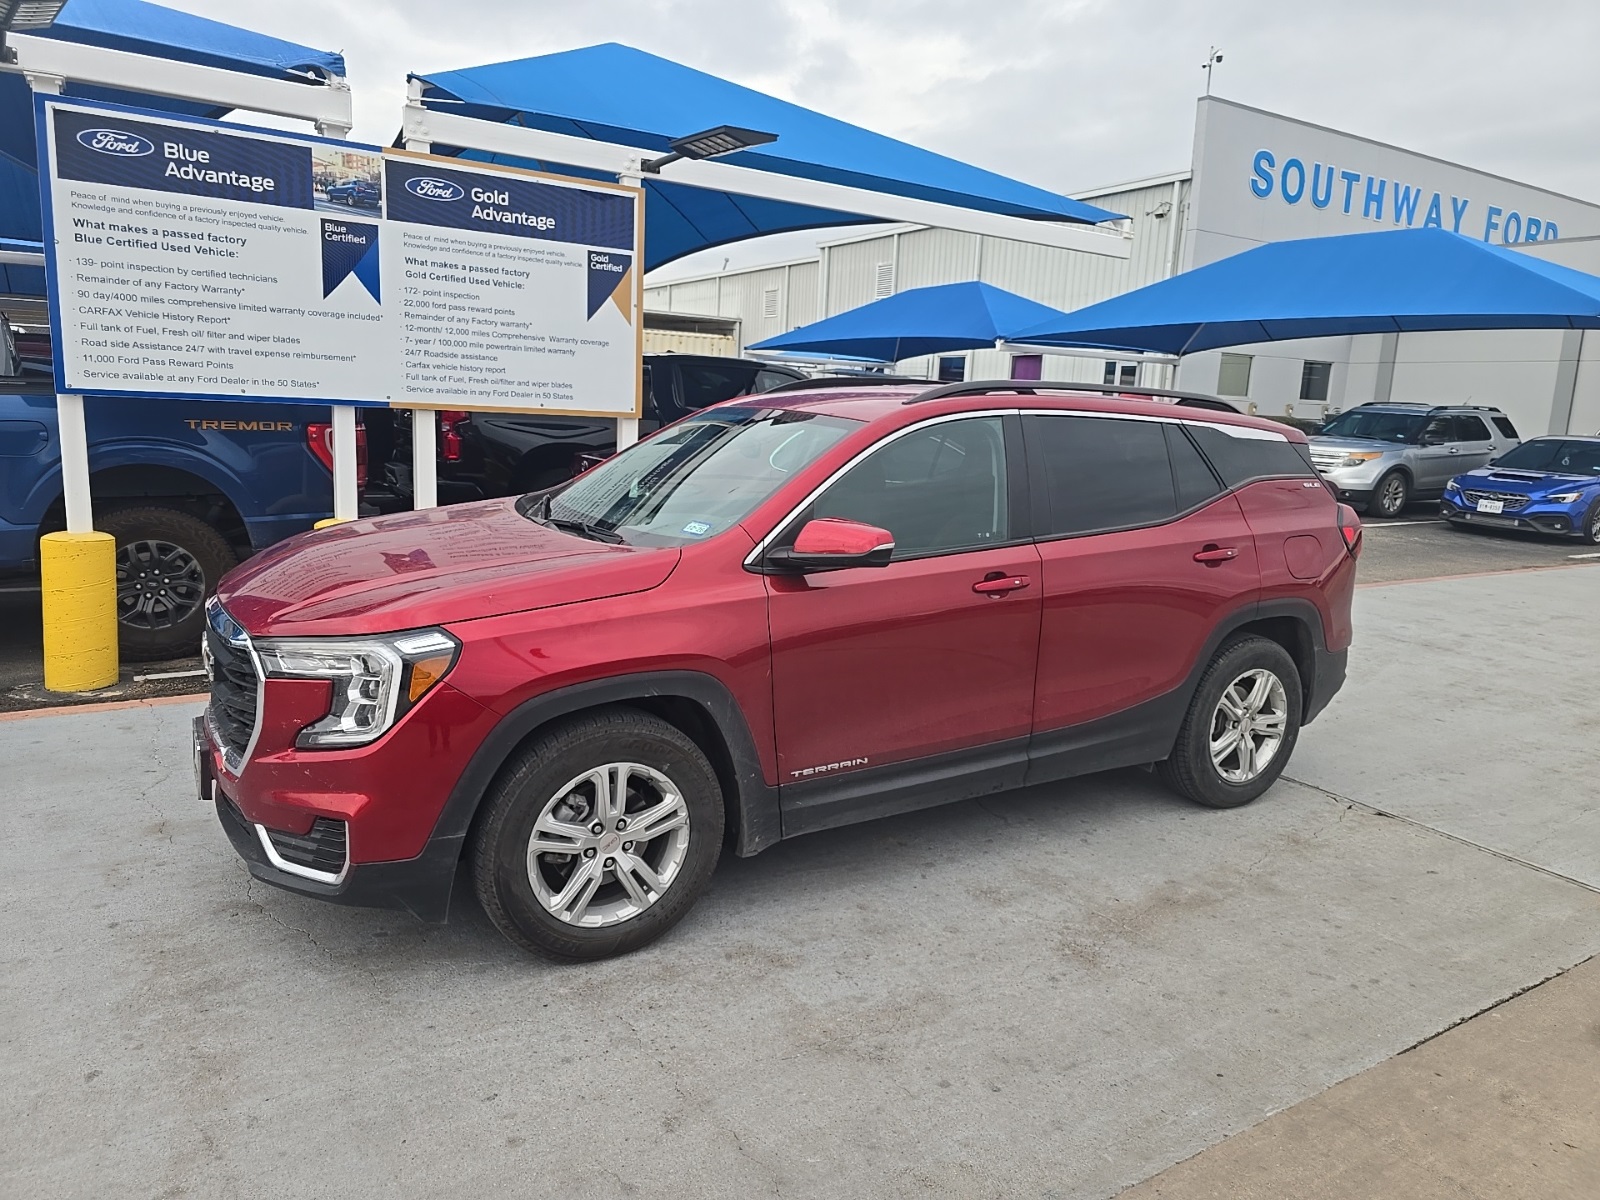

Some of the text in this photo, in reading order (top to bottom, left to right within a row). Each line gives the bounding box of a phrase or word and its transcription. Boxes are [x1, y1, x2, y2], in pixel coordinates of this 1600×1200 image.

[92, 131, 140, 153] Ford
[163, 141, 209, 163] Blue
[164, 161, 274, 192] Advantage
[416, 179, 454, 198] Ford
[470, 187, 508, 205] Gold
[1250, 149, 1470, 233] SOUTHWAY
[471, 204, 555, 230] Advantage
[72, 217, 105, 230] What
[108, 223, 148, 234] makes
[161, 229, 204, 240] passed
[206, 232, 246, 247] factory
[324, 222, 346, 232] Blue
[74, 232, 238, 258] Blue Certified Used Vehicle:
[324, 231, 366, 244] Certified
[590, 253, 608, 262] Gold
[590, 261, 622, 272] Certified
[75, 257, 278, 283] 139- point inspection by certified technicians
[404, 256, 427, 266] What
[430, 260, 458, 269] makes
[468, 265, 498, 274] passed
[501, 267, 530, 279] factory
[76, 273, 130, 285] Remainder
[132, 278, 142, 286] of
[144, 281, 161, 289] any
[164, 281, 198, 292] Factory
[405, 269, 524, 289] Gold Certified Used Vehicle:
[403, 298, 430, 307] 22,000
[431, 301, 446, 309] ford
[422, 289, 441, 297] point
[442, 291, 479, 300] inspection
[76, 289, 89, 298] 90
[92, 291, 137, 302] day/4000
[140, 295, 165, 304] miles
[167, 298, 236, 309] comprehensive
[238, 302, 266, 312] limited
[268, 306, 305, 316] warranty
[307, 310, 345, 319] coverage
[78, 305, 122, 316] CARFAX
[124, 308, 159, 319] Vehicle
[162, 311, 194, 323] History
[404, 311, 445, 321] Remainder
[456, 317, 469, 325] any
[471, 316, 497, 327] Factory
[79, 321, 97, 330] Full
[100, 323, 121, 332] tank
[135, 325, 159, 335] Fuel,
[161, 327, 188, 336] Fresh
[190, 329, 204, 337] oil/
[206, 330, 226, 338] filter
[227, 332, 244, 340] and
[246, 333, 270, 342] wiper
[272, 335, 300, 344] blades
[444, 326, 469, 335] 12,000
[471, 329, 490, 337] miles
[491, 330, 545, 341] Comprehensive
[548, 335, 578, 345] Warranty
[579, 339, 609, 347] coverage
[81, 337, 107, 347] Road
[110, 339, 129, 348] side
[131, 340, 182, 351] Assistance
[185, 344, 204, 352] 24/7
[227, 347, 252, 355] travel
[254, 350, 290, 358] expense
[423, 349, 458, 358] Roadside
[460, 353, 497, 361] assistance
[438, 338, 467, 347] 100,000
[485, 343, 522, 351] powertrain
[523, 345, 545, 353] limited
[547, 348, 575, 356] warranty
[82, 353, 233, 369] 11,000 Ford Pass Reward Points
[405, 360, 430, 368] Carfax
[459, 364, 483, 373] history
[83, 369, 119, 378] Service
[122, 371, 163, 381] available
[177, 375, 194, 383] any
[196, 375, 217, 383] Ford
[220, 376, 249, 384] Dealer
[251, 377, 259, 385] in
[261, 378, 274, 386] the
[405, 372, 419, 380] Full
[438, 374, 446, 382] of
[405, 385, 433, 393] Service
[492, 389, 508, 397] Ford
[552, 392, 573, 400] States
[184, 419, 293, 432] TREMOR
[790, 757, 869, 778] TERRAIN
